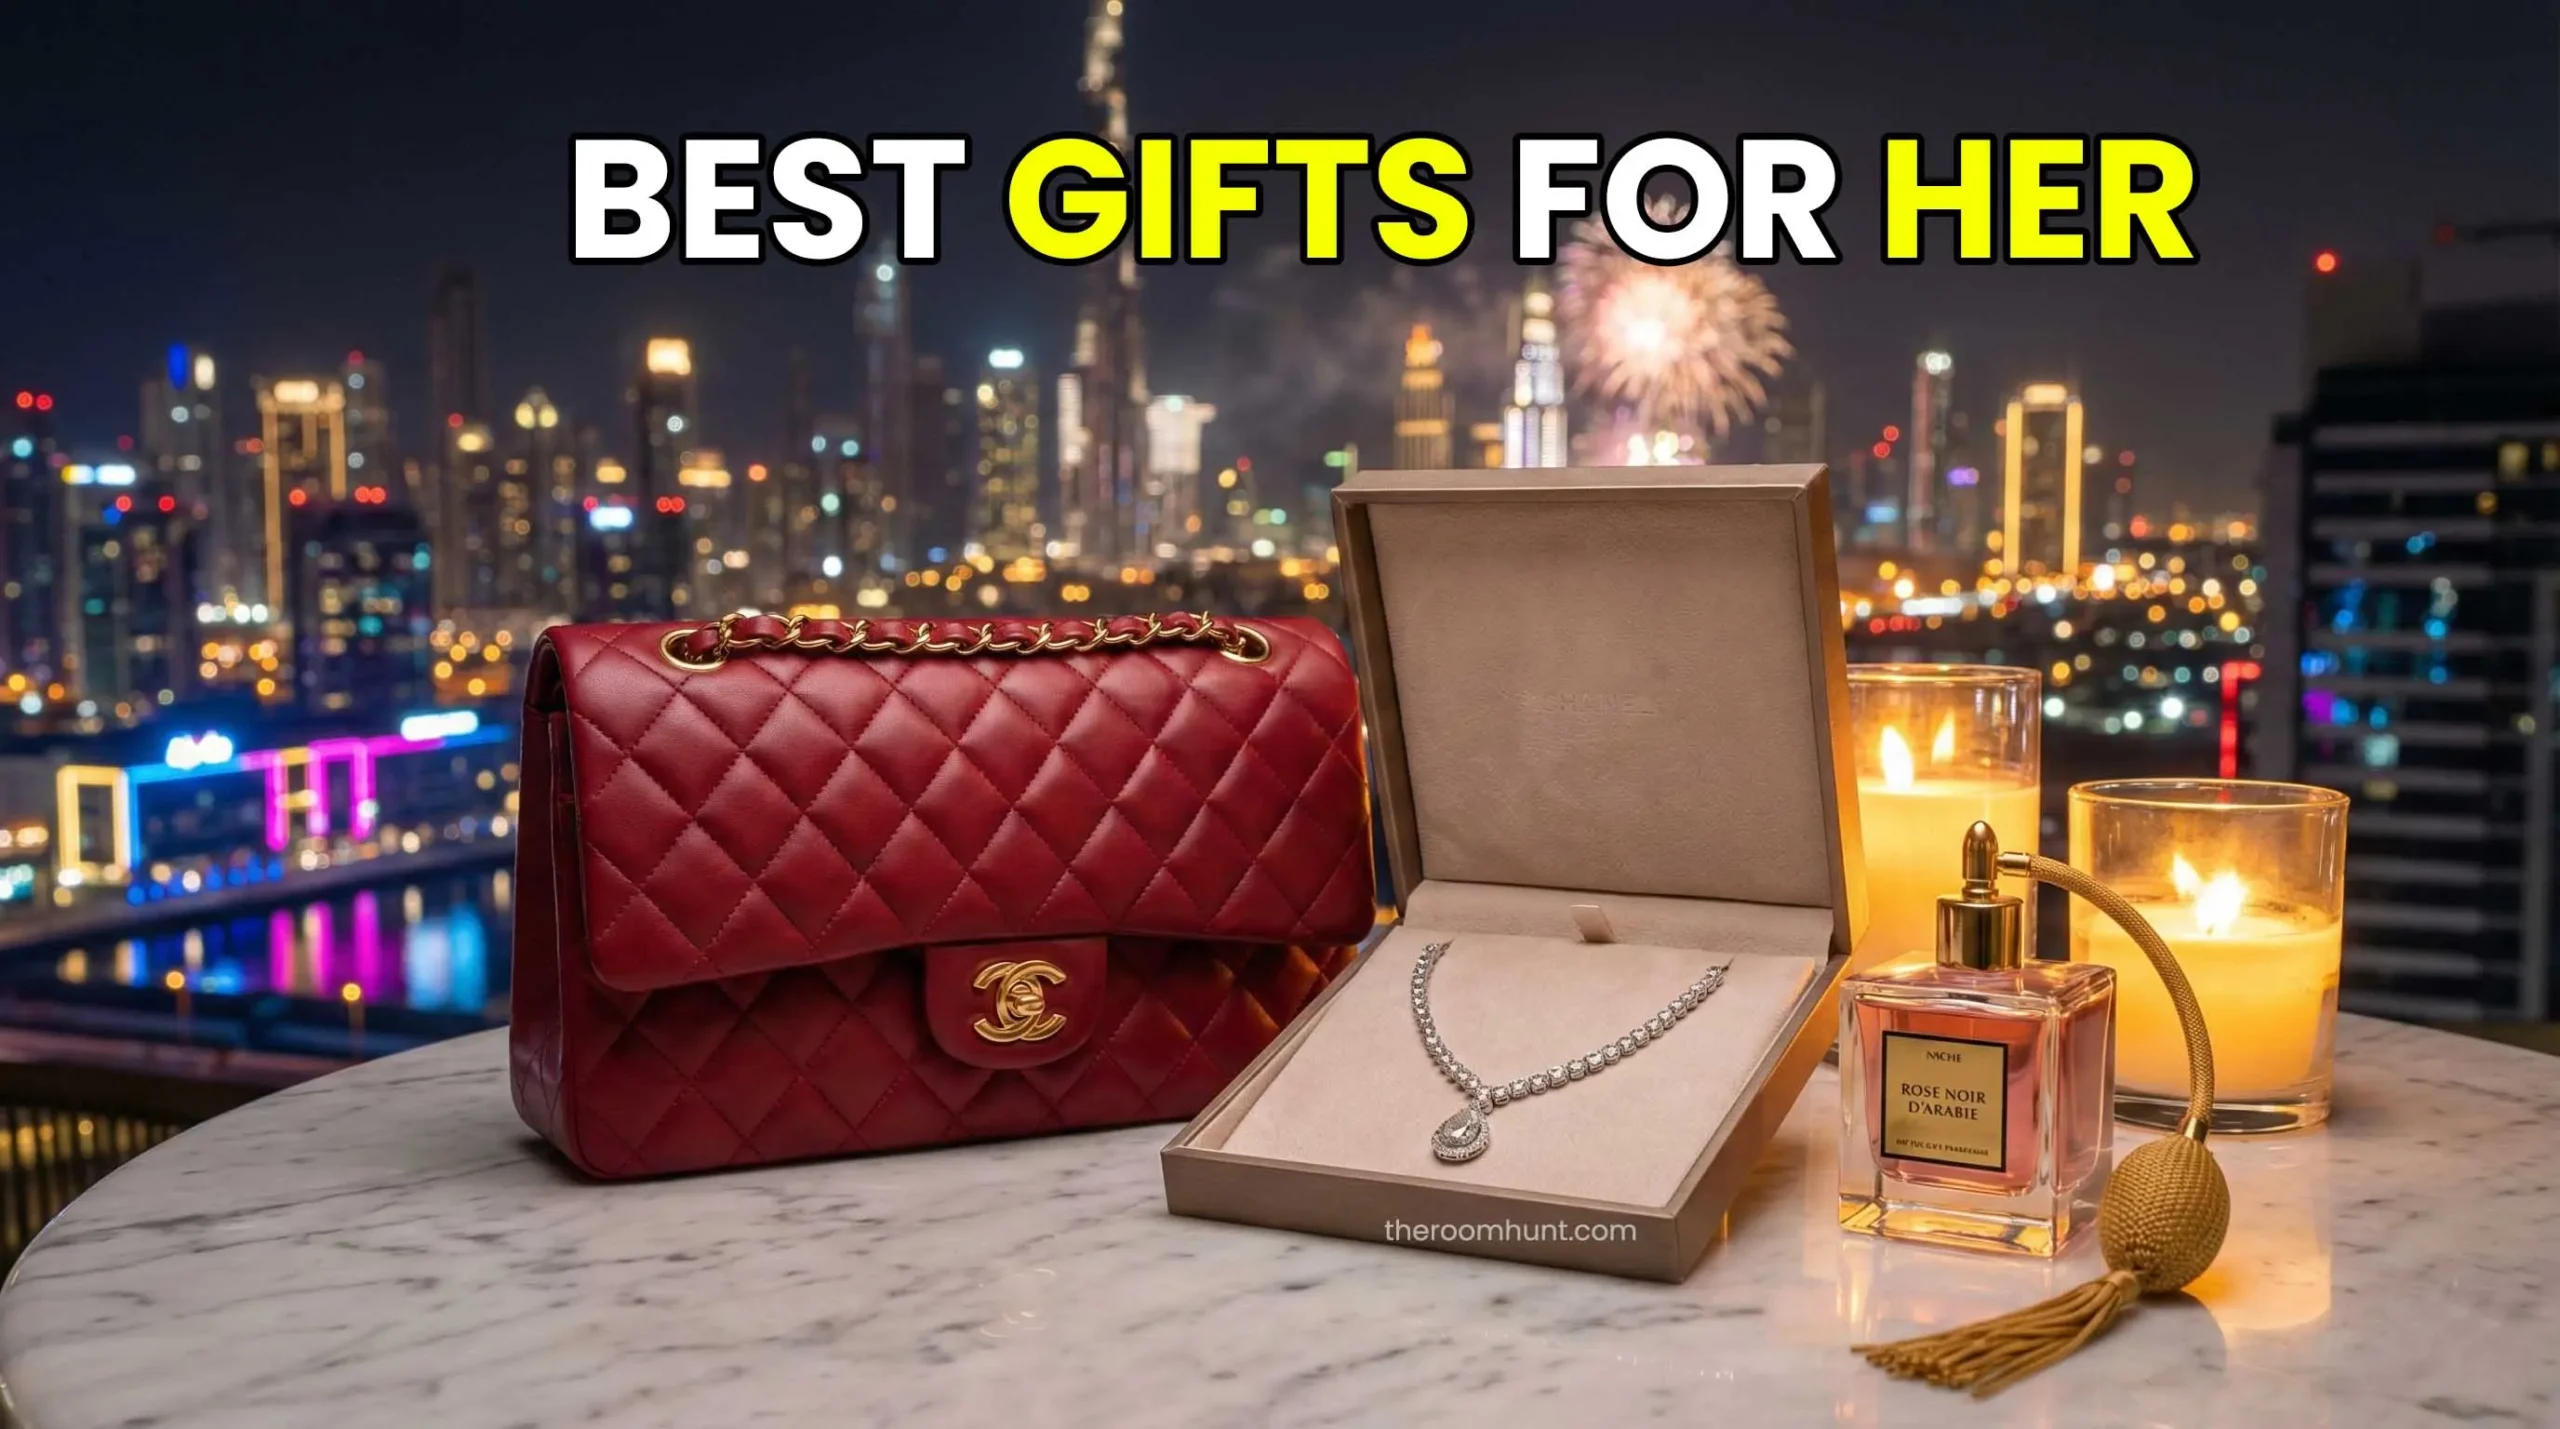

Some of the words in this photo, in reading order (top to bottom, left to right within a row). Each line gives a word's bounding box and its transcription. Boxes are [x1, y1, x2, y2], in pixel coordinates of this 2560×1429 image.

[1901, 1082, 1940, 1099] ROSE
[1945, 1088, 1986, 1104] NOIR
[1908, 1100, 1978, 1121] D'ARABIE
